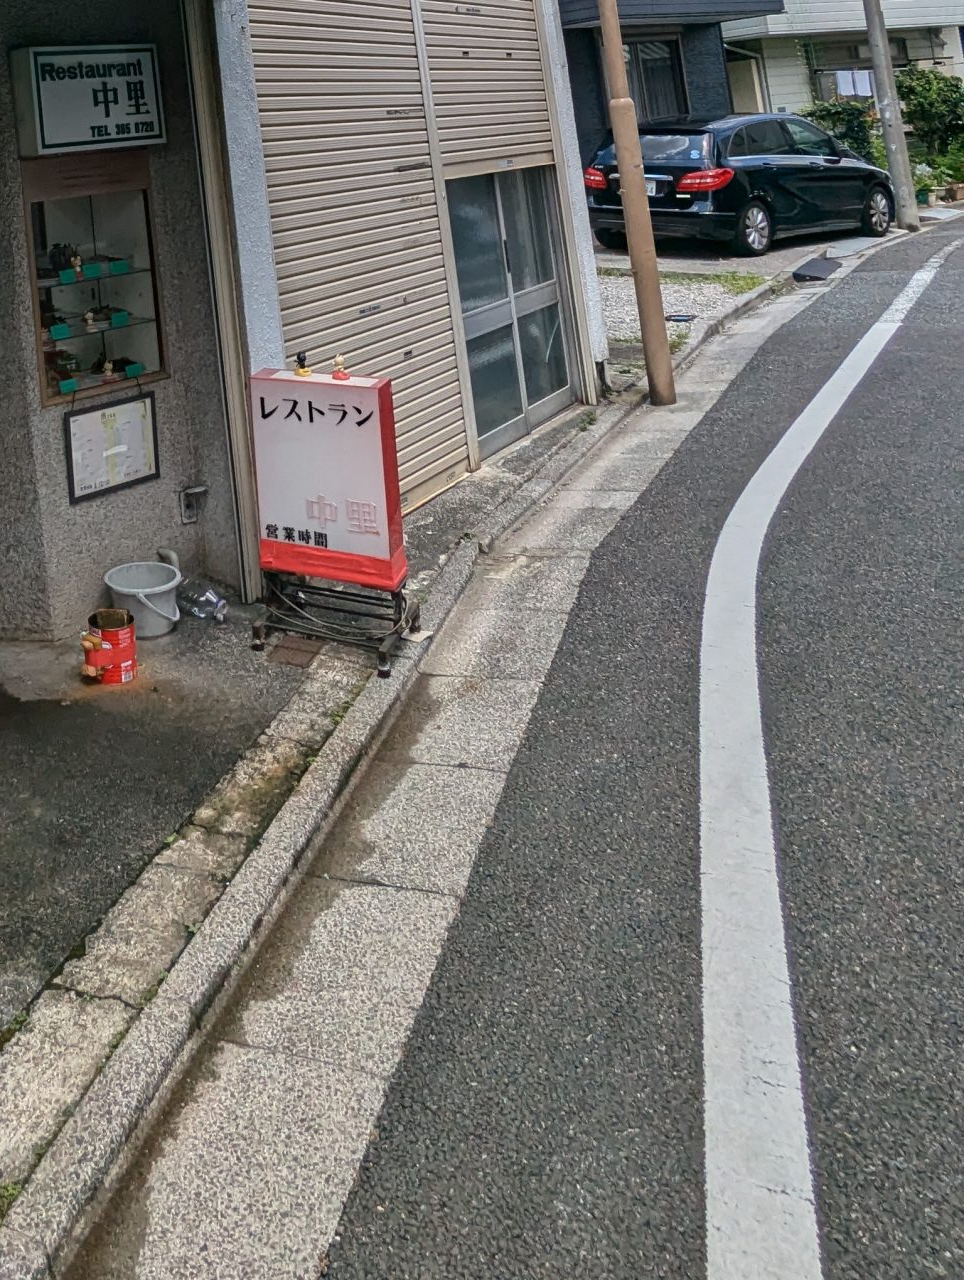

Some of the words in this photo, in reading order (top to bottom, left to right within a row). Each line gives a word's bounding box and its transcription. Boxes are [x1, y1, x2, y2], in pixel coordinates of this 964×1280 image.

[40, 58, 143, 82] Restaurant
[92, 80, 151, 118] 中里
[91, 125, 111, 138] TEL
[115, 122, 131, 135] 385
[259, 396, 374, 427] レストラン
[306, 493, 381, 536] 中里
[265, 524, 328, 548] 営業時間
